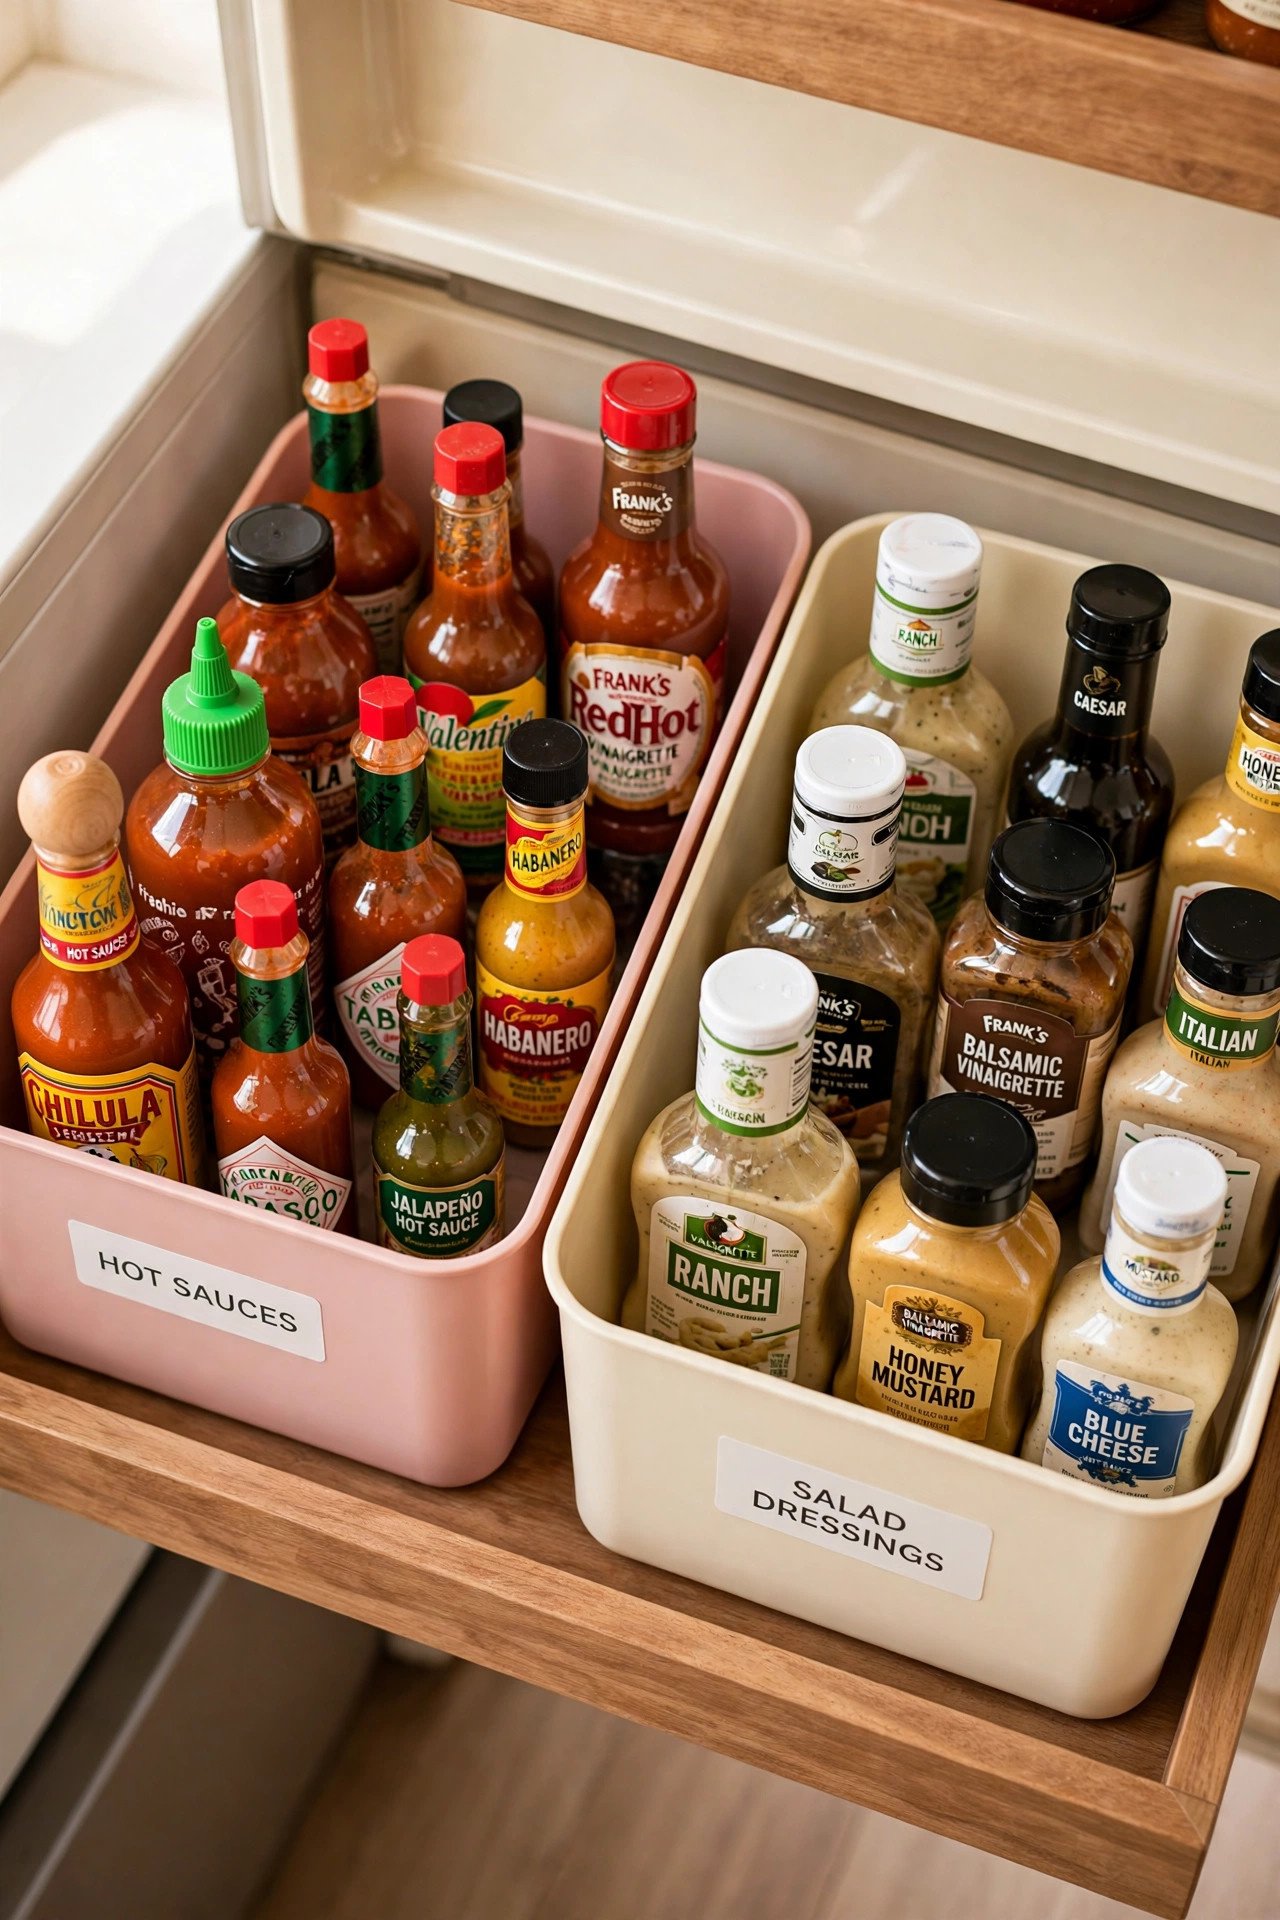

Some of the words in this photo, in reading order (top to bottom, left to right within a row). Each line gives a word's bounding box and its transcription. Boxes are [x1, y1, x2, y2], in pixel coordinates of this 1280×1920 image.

[612, 486, 674, 513] FRANK'S
[898, 629, 938, 647] RANCH
[593, 668, 672, 697] FRANK'S
[570, 680, 700, 746] RedHot
[1074, 690, 1127, 716] CAESAR
[587, 735, 679, 765] VINAIGRETTE
[1242, 751, 1280, 782] HONE
[512, 832, 582, 872] HABANERO
[66, 947, 89, 960] HOT
[819, 996, 855, 1016] NK'S
[485, 1010, 591, 1056] HABANERO
[983, 1015, 1049, 1044] FRANK'S
[1178, 1011, 1259, 1052] ITALIAN
[812, 1039, 873, 1069] ESAR
[963, 1032, 1063, 1077] BALSAMIC
[1190, 1049, 1231, 1068] ITALIAN
[957, 1053, 1065, 1099] VINAIGRETTE
[391, 1190, 484, 1219] JALAPEÑO
[395, 1212, 425, 1235] HOT
[428, 1212, 480, 1237] SAUCE
[98, 1251, 162, 1287] HOT
[172, 1277, 298, 1333] SAUCES
[674, 1253, 772, 1307] RANCH
[888, 1345, 965, 1386] HONEY
[871, 1360, 976, 1410] MUSTARD
[1068, 1422, 1159, 1465] CHEESE
[1084, 1408, 1147, 1444] BLUE
[793, 1480, 907, 1532] SALAD
[752, 1489, 944, 1572] DRESSINGS
